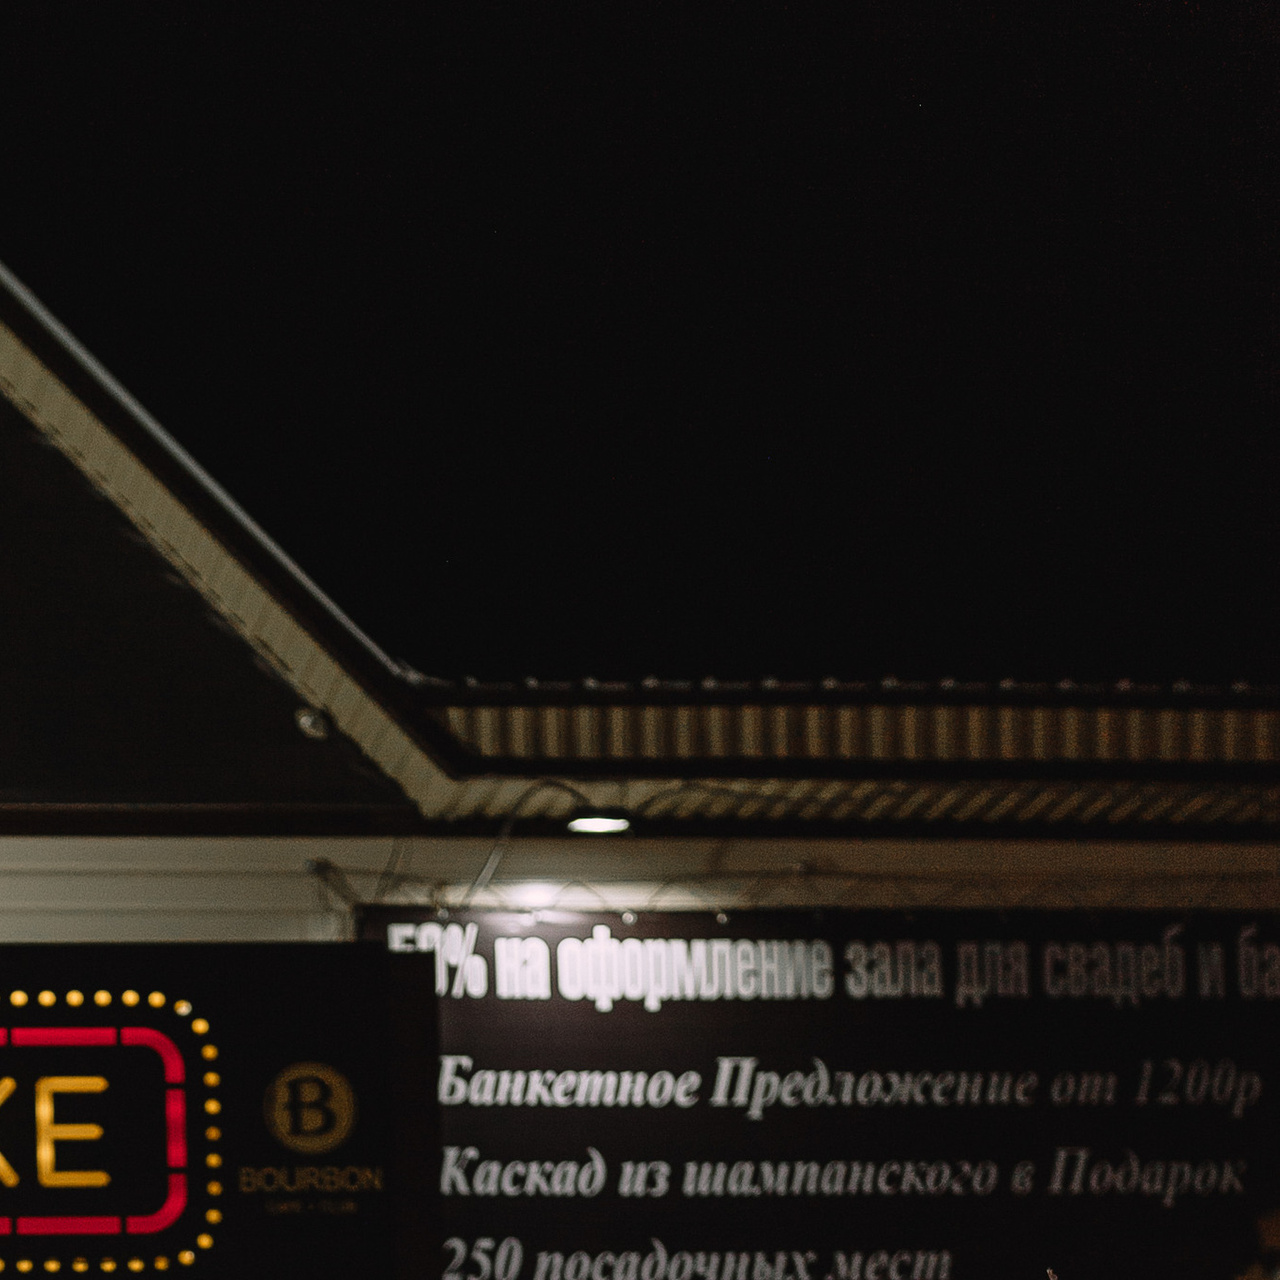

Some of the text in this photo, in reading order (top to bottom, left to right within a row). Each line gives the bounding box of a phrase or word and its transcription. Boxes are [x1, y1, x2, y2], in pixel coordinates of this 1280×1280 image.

[494, 936, 552, 1000] на
[556, 924, 833, 1012] оформление
[844, 939, 944, 999] зала
[954, 939, 1030, 1009] для
[1041, 923, 1187, 1010] свадеб
[1196, 940, 1227, 1000] и
[438, 1054, 1265, 1121] Банкетное Предложение от 1200р
[238, 1165, 385, 1193] BOURBON
[439, 1145, 1248, 1208] Каскад из шампанского в Подарок
